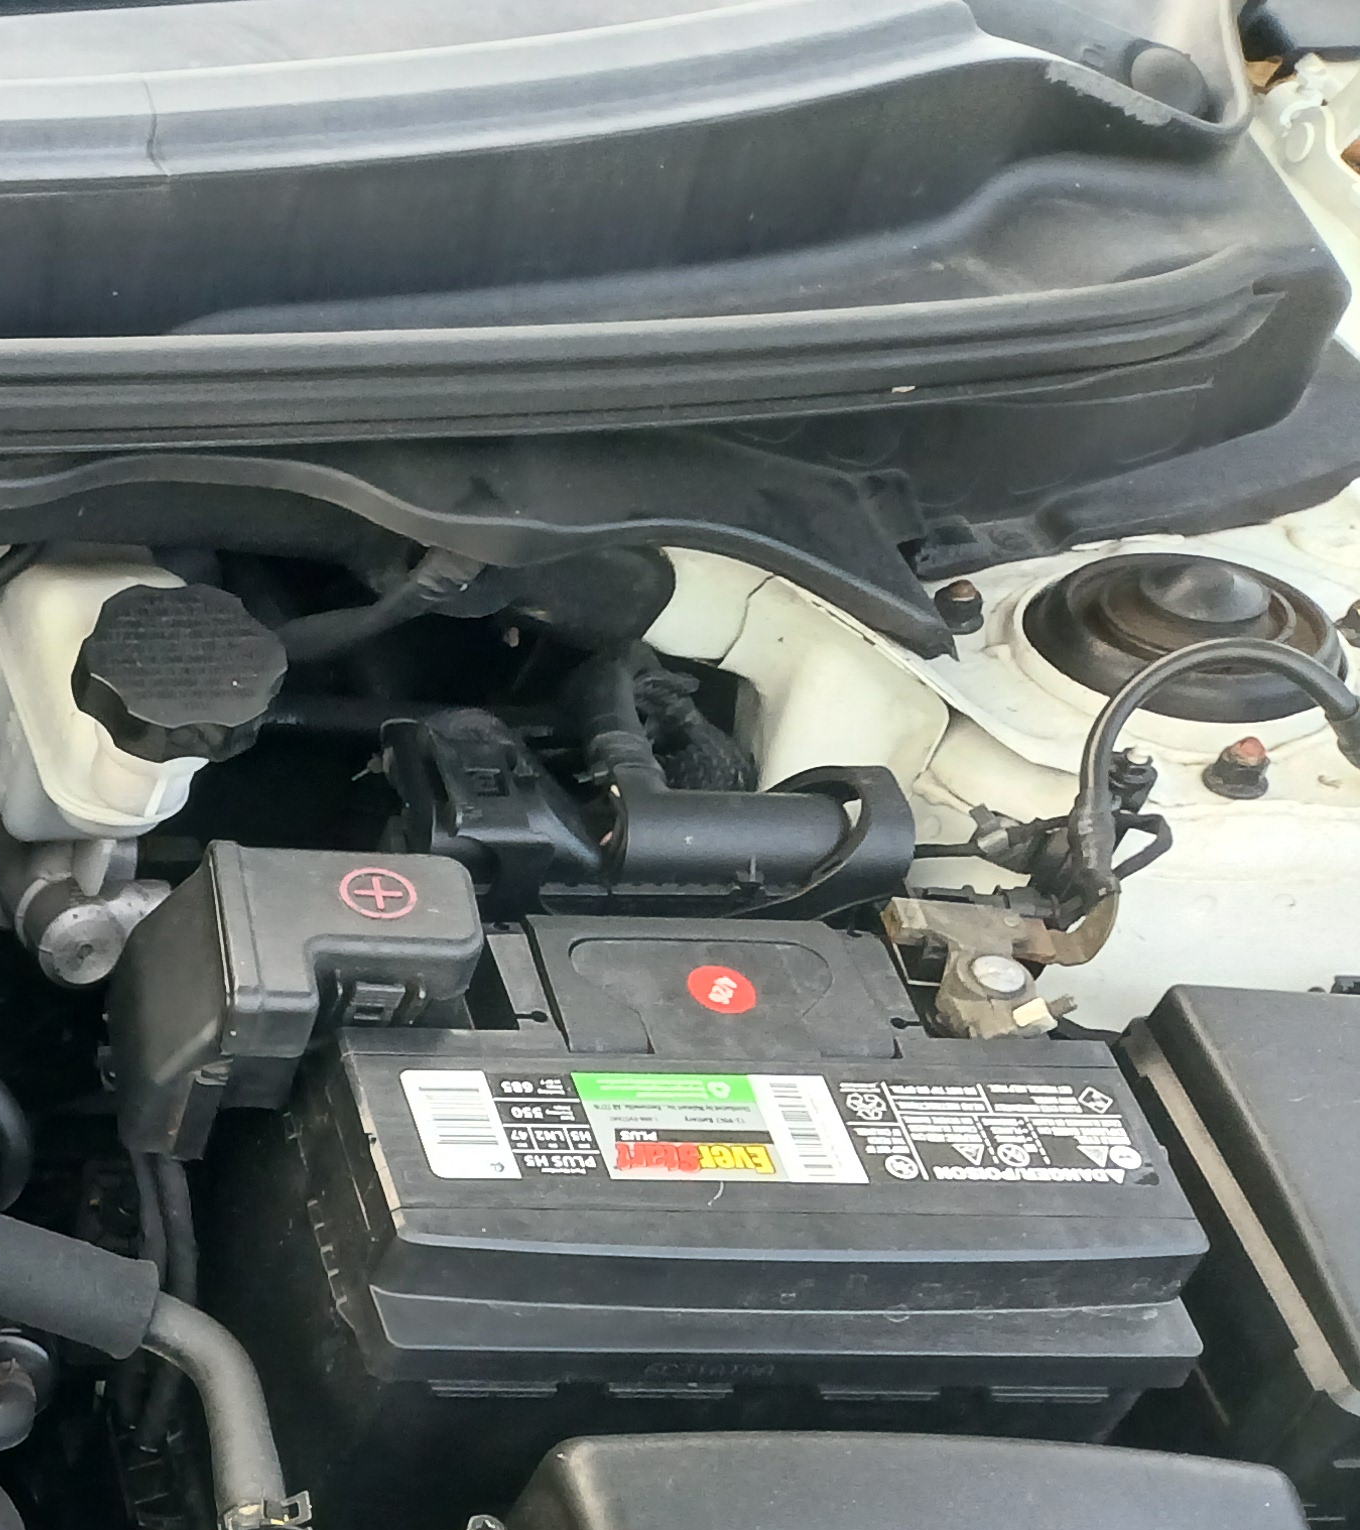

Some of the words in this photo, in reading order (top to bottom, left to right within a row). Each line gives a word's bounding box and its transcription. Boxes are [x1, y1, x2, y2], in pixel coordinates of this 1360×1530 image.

[510, 1106, 544, 1119] 550
[510, 1129, 529, 1141] 47
[534, 1129, 565, 1142] LN2
[569, 1129, 593, 1142] H5
[619, 1130, 659, 1142] PLUS
[523, 1154, 550, 1167] H5
[551, 1154, 597, 1168] PLUS
[615, 1141, 776, 1175] EverStart
